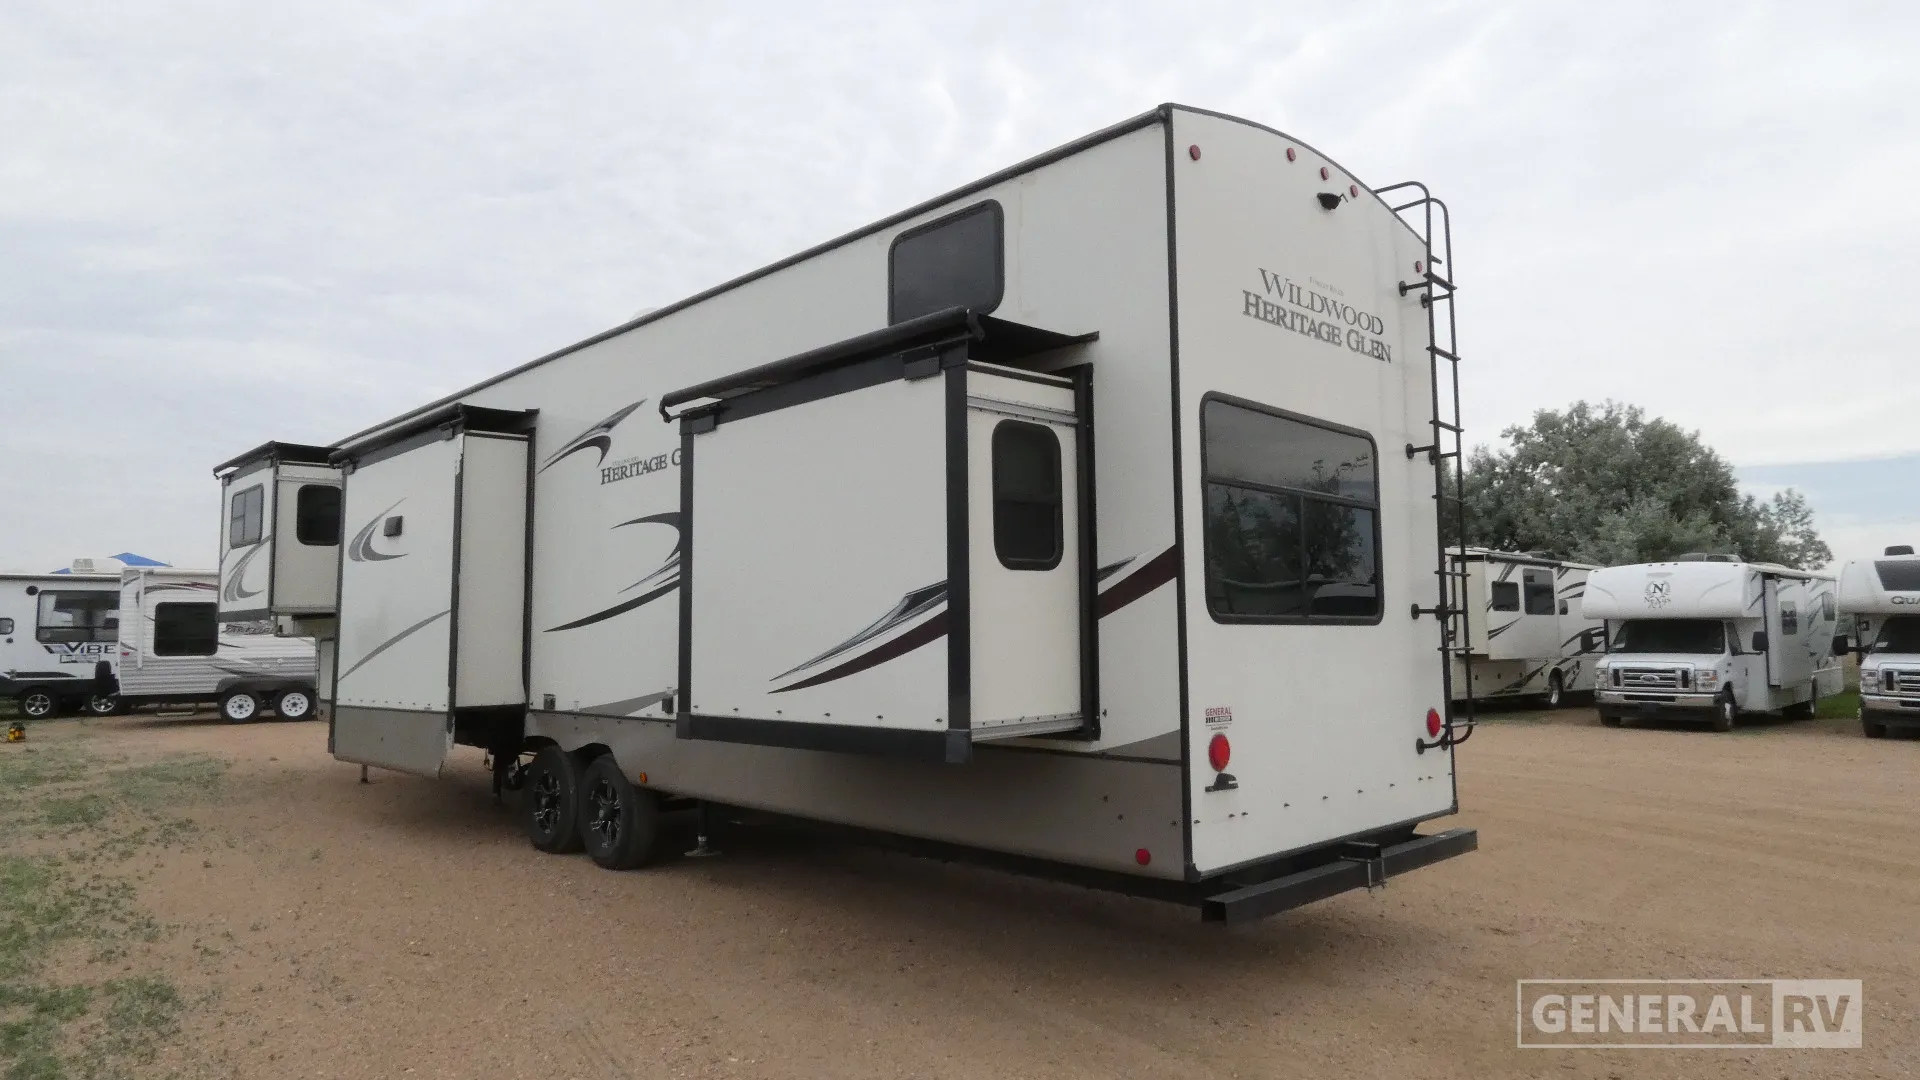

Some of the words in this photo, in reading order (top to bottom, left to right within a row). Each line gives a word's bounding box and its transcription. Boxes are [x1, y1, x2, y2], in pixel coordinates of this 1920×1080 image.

[1258, 267, 1384, 335] WILDWOOD
[1242, 290, 1342, 347] HERITAGE
[1346, 329, 1391, 364] GLEN
[600, 453, 668, 485] HERITAGE
[1652, 583, 1665, 594] N
[1205, 707, 1232, 717] GENERAL
